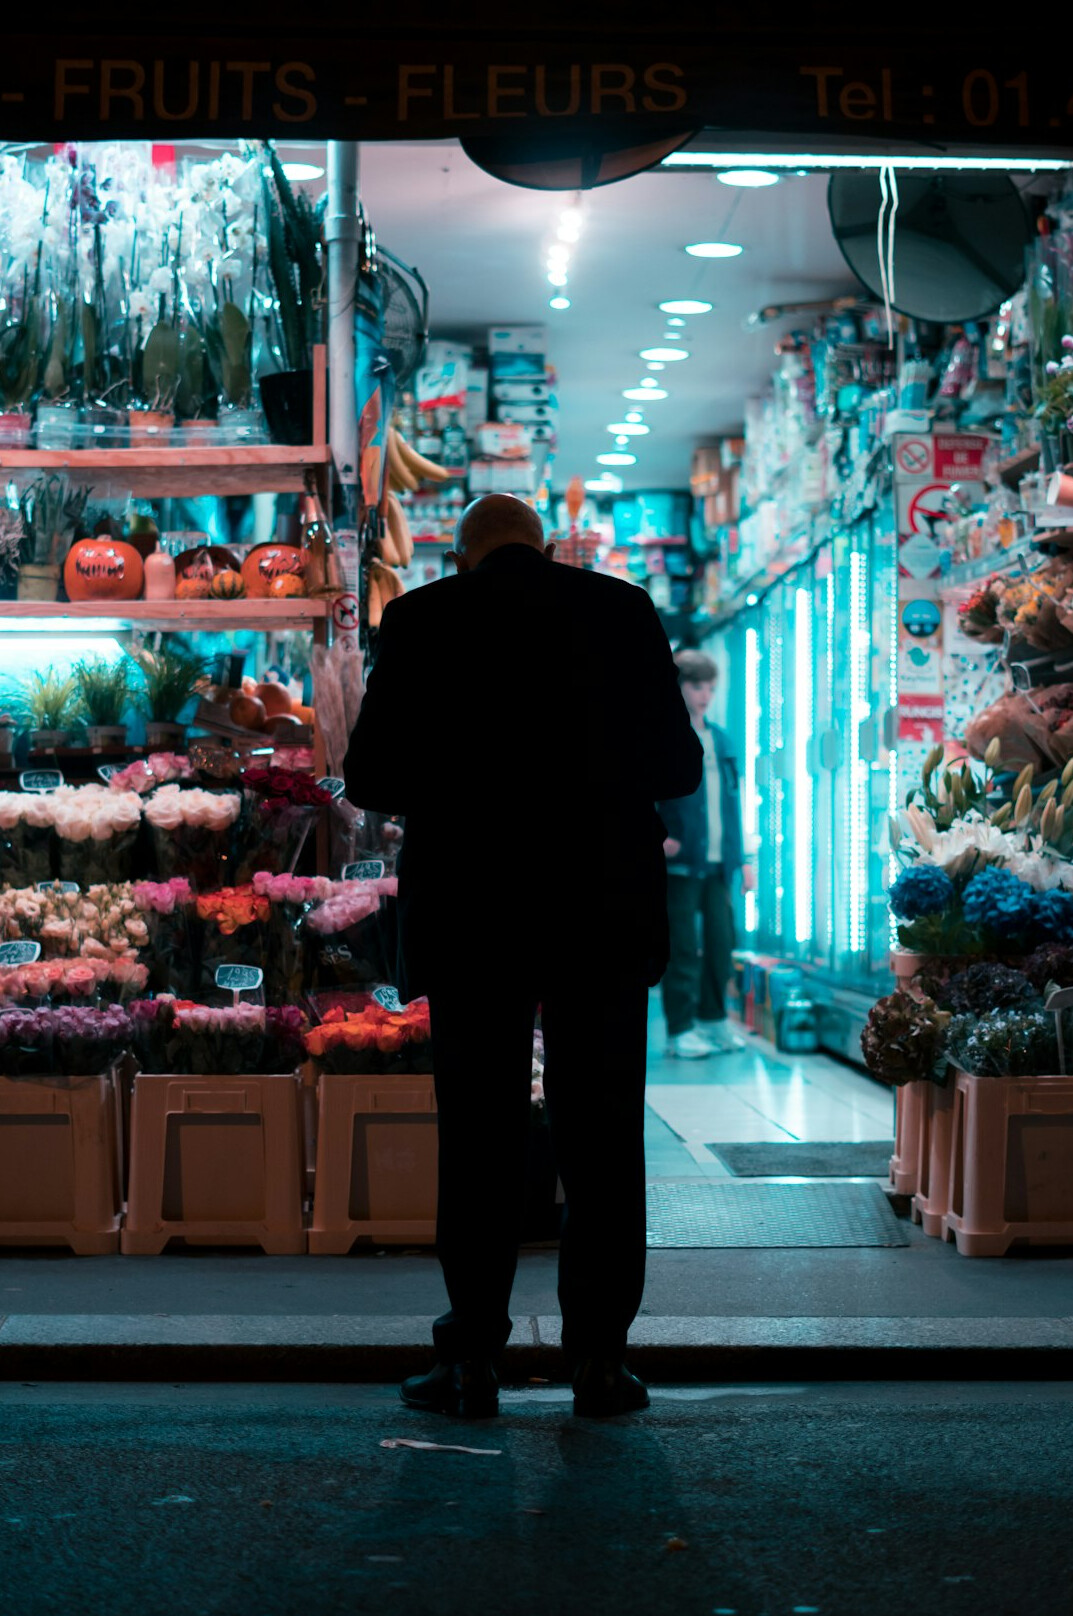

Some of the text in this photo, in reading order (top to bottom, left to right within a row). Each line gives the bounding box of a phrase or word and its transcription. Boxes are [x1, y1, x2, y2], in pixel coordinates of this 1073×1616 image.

[53, 58, 318, 122] FRUITS
[397, 62, 687, 121] FLEURS
[799, 66, 893, 122] Tel
